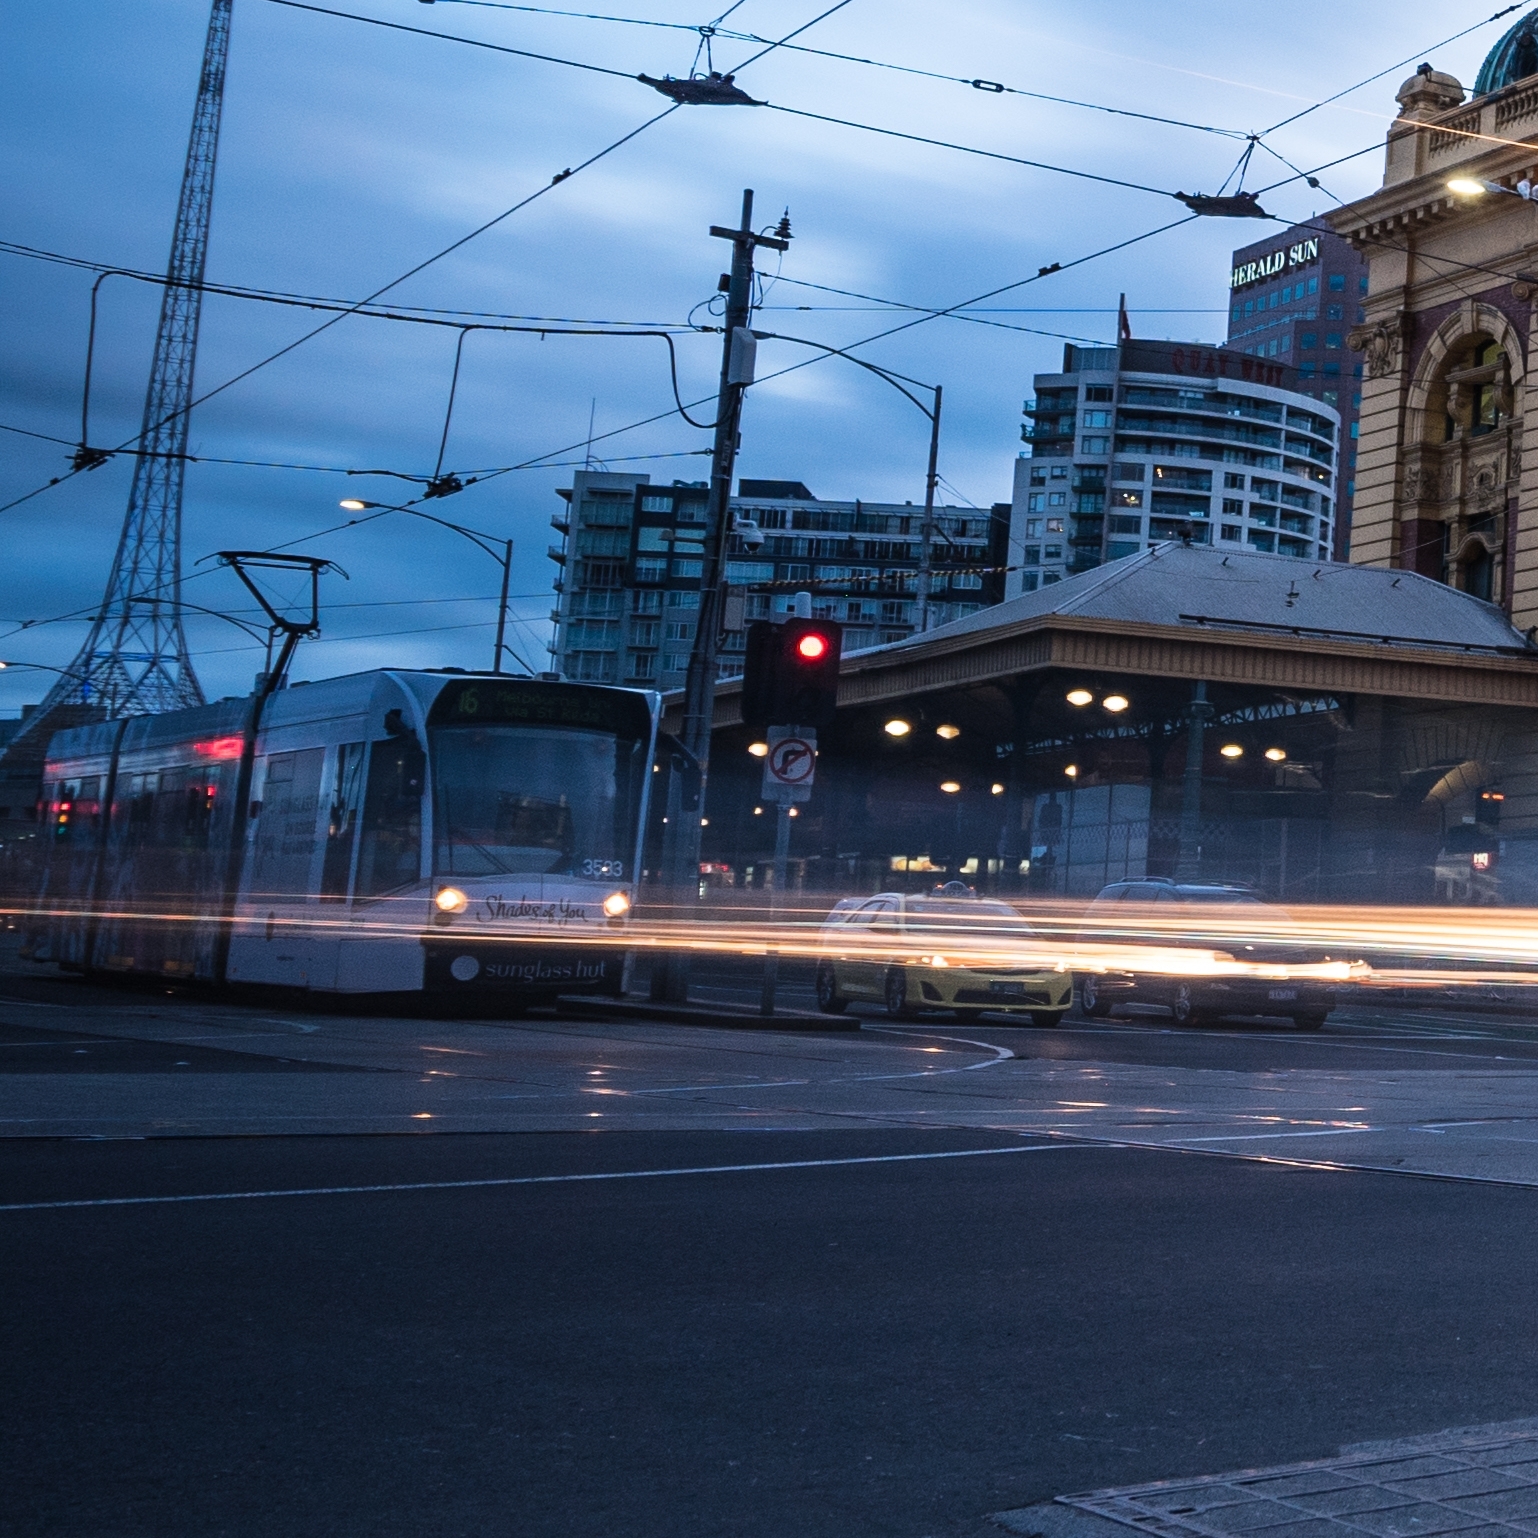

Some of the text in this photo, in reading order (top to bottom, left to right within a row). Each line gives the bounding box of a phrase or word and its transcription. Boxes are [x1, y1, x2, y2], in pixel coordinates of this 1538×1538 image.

[1229, 237, 1319, 288] HERALD SUN
[476, 894, 588, 928] Shades of You
[485, 959, 607, 984] sunglass hut
